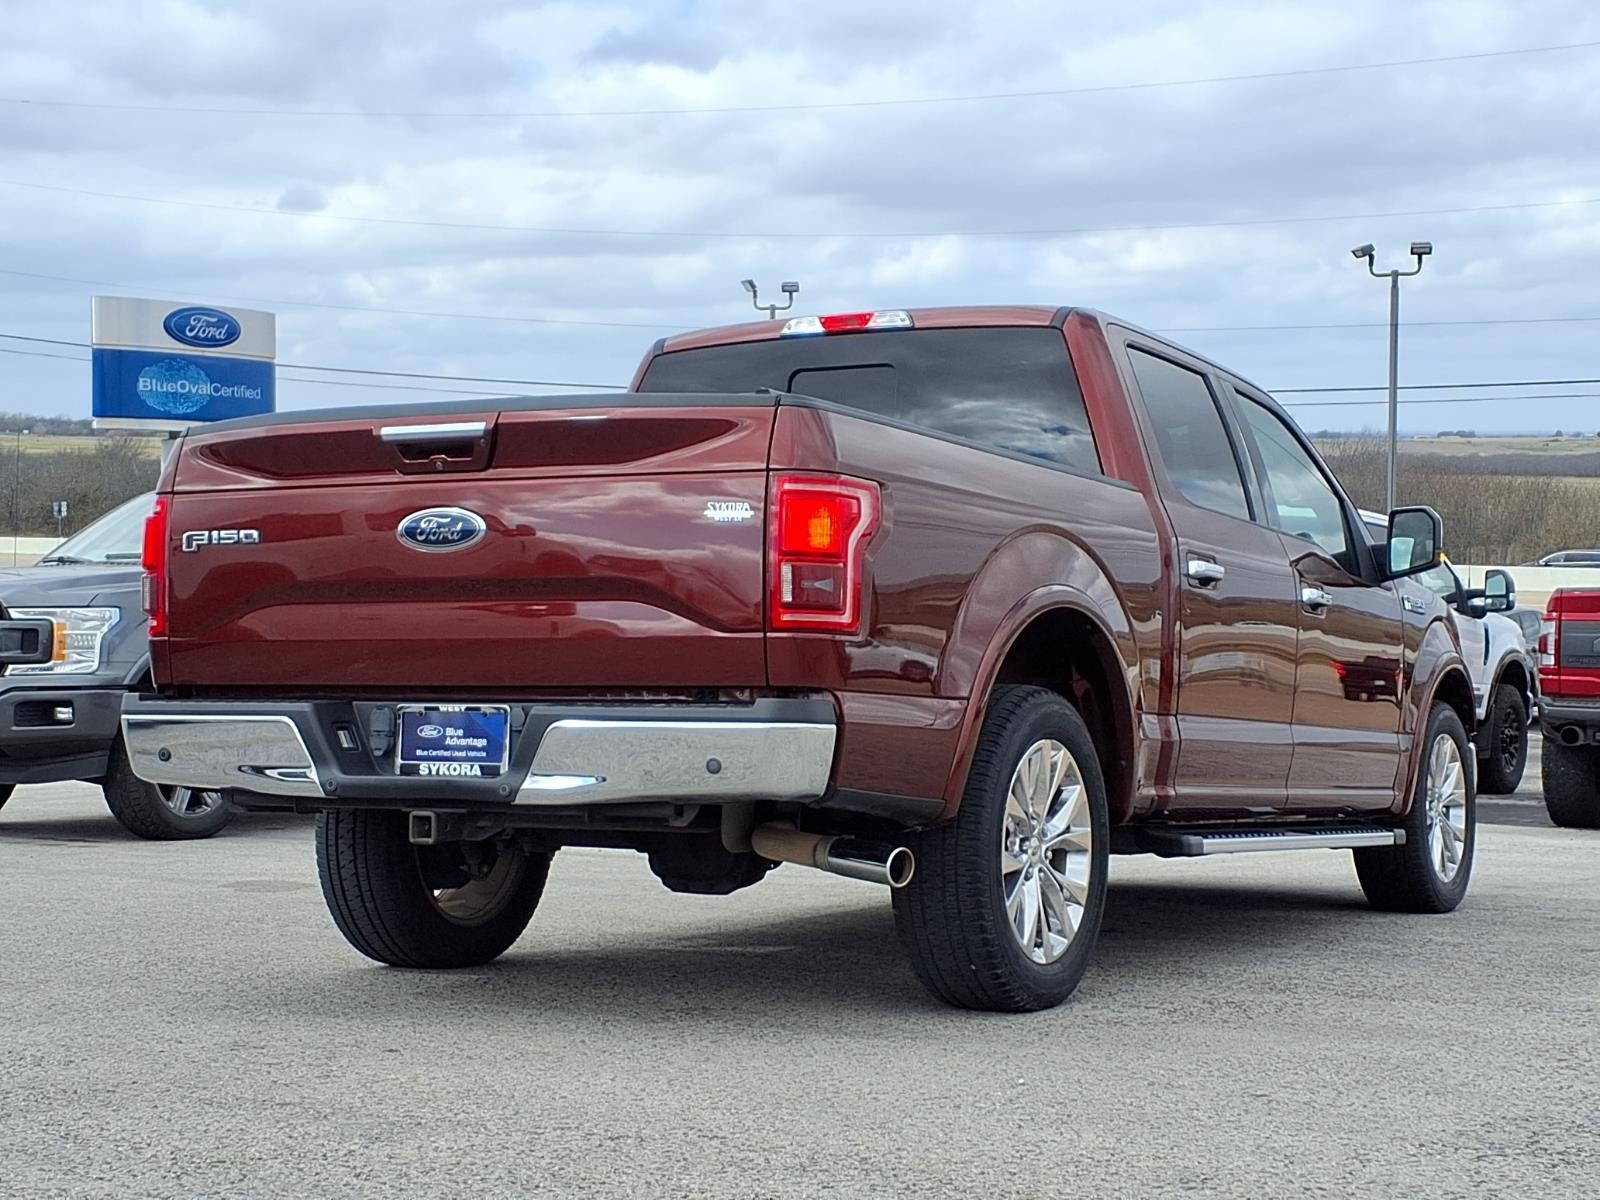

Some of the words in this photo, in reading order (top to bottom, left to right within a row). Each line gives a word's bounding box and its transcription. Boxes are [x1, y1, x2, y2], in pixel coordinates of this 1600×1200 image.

[185, 314, 229, 340] Ford
[138, 377, 261, 400] BlueOvalCertified
[707, 501, 751, 512] SYKORA
[416, 516, 463, 541] Ford
[439, 704, 466, 712] WEST
[445, 727, 464, 736] Blue
[445, 736, 488, 748] Advantage
[428, 749, 451, 757] Certified
[418, 763, 482, 776] SYKORA
